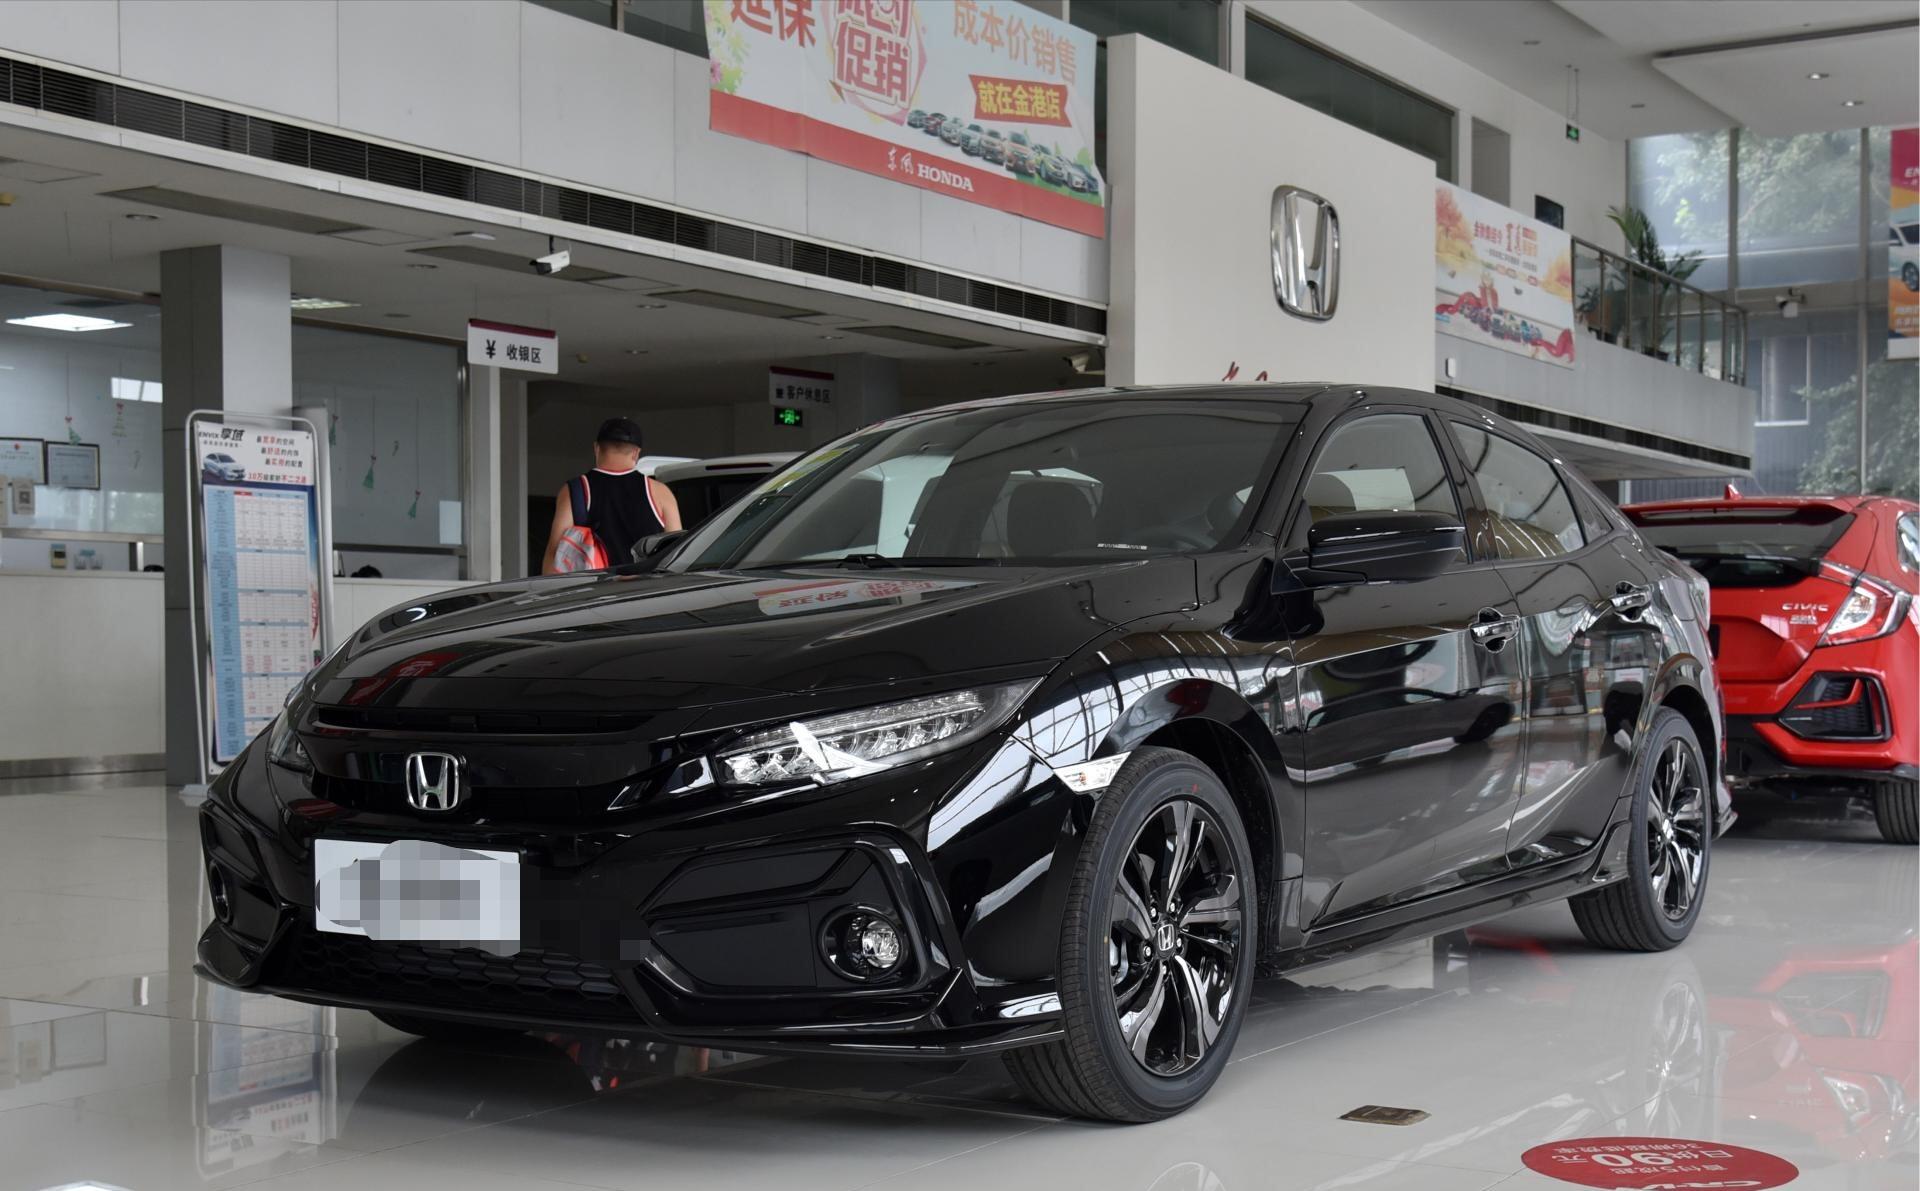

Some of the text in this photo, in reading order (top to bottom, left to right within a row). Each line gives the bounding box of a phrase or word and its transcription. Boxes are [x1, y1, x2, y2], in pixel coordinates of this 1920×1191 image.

[953, 0, 1077, 85] 成本价销售
[836, 21, 908, 102] 促销
[977, 80, 1061, 119] 就在金港店
[917, 163, 975, 192] HONDA
[506, 344, 541, 364] 收银区
[787, 385, 830, 403] 客户休息区
[1782, 602, 1829, 612] CIVIC
